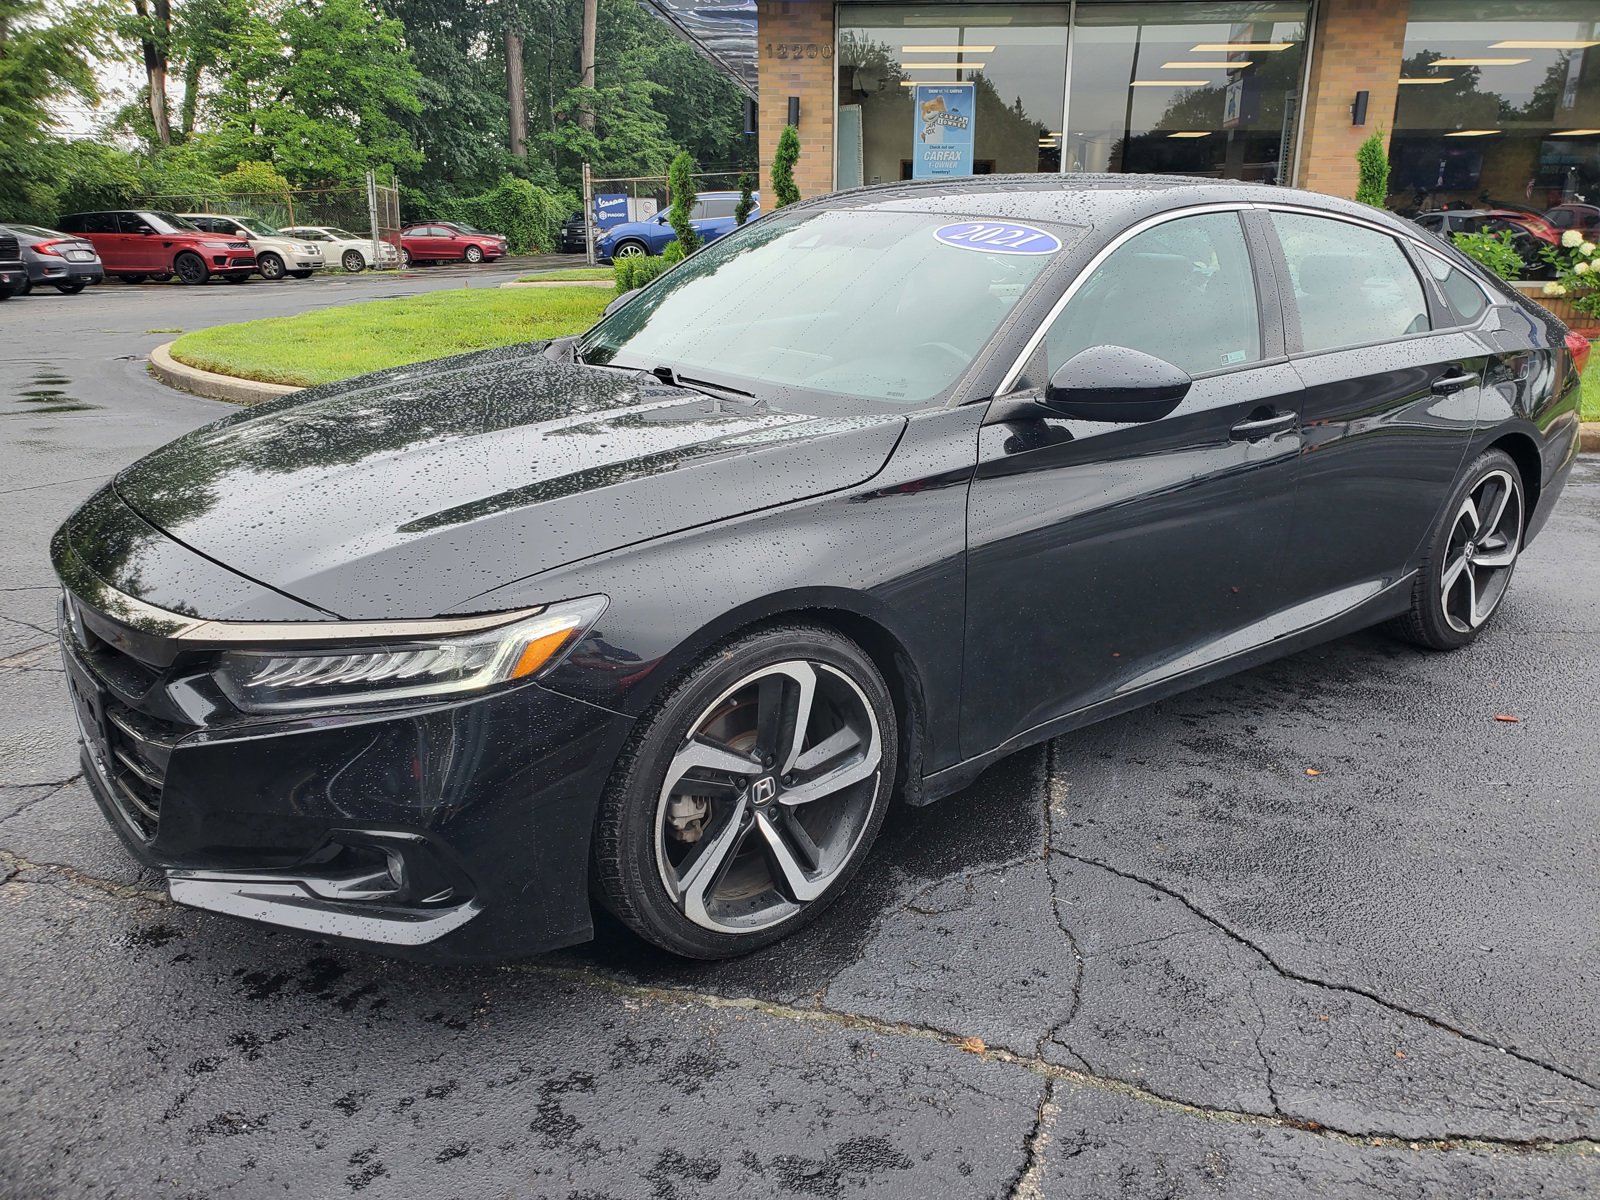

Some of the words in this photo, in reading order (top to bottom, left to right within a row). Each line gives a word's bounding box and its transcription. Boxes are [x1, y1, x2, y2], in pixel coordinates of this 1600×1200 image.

[765, 43, 833, 59] 12200
[923, 151, 962, 161] CARFAX
[928, 161, 958, 169] 1-OWNER
[597, 197, 625, 209] Vespa
[946, 224, 1045, 249] 2021
